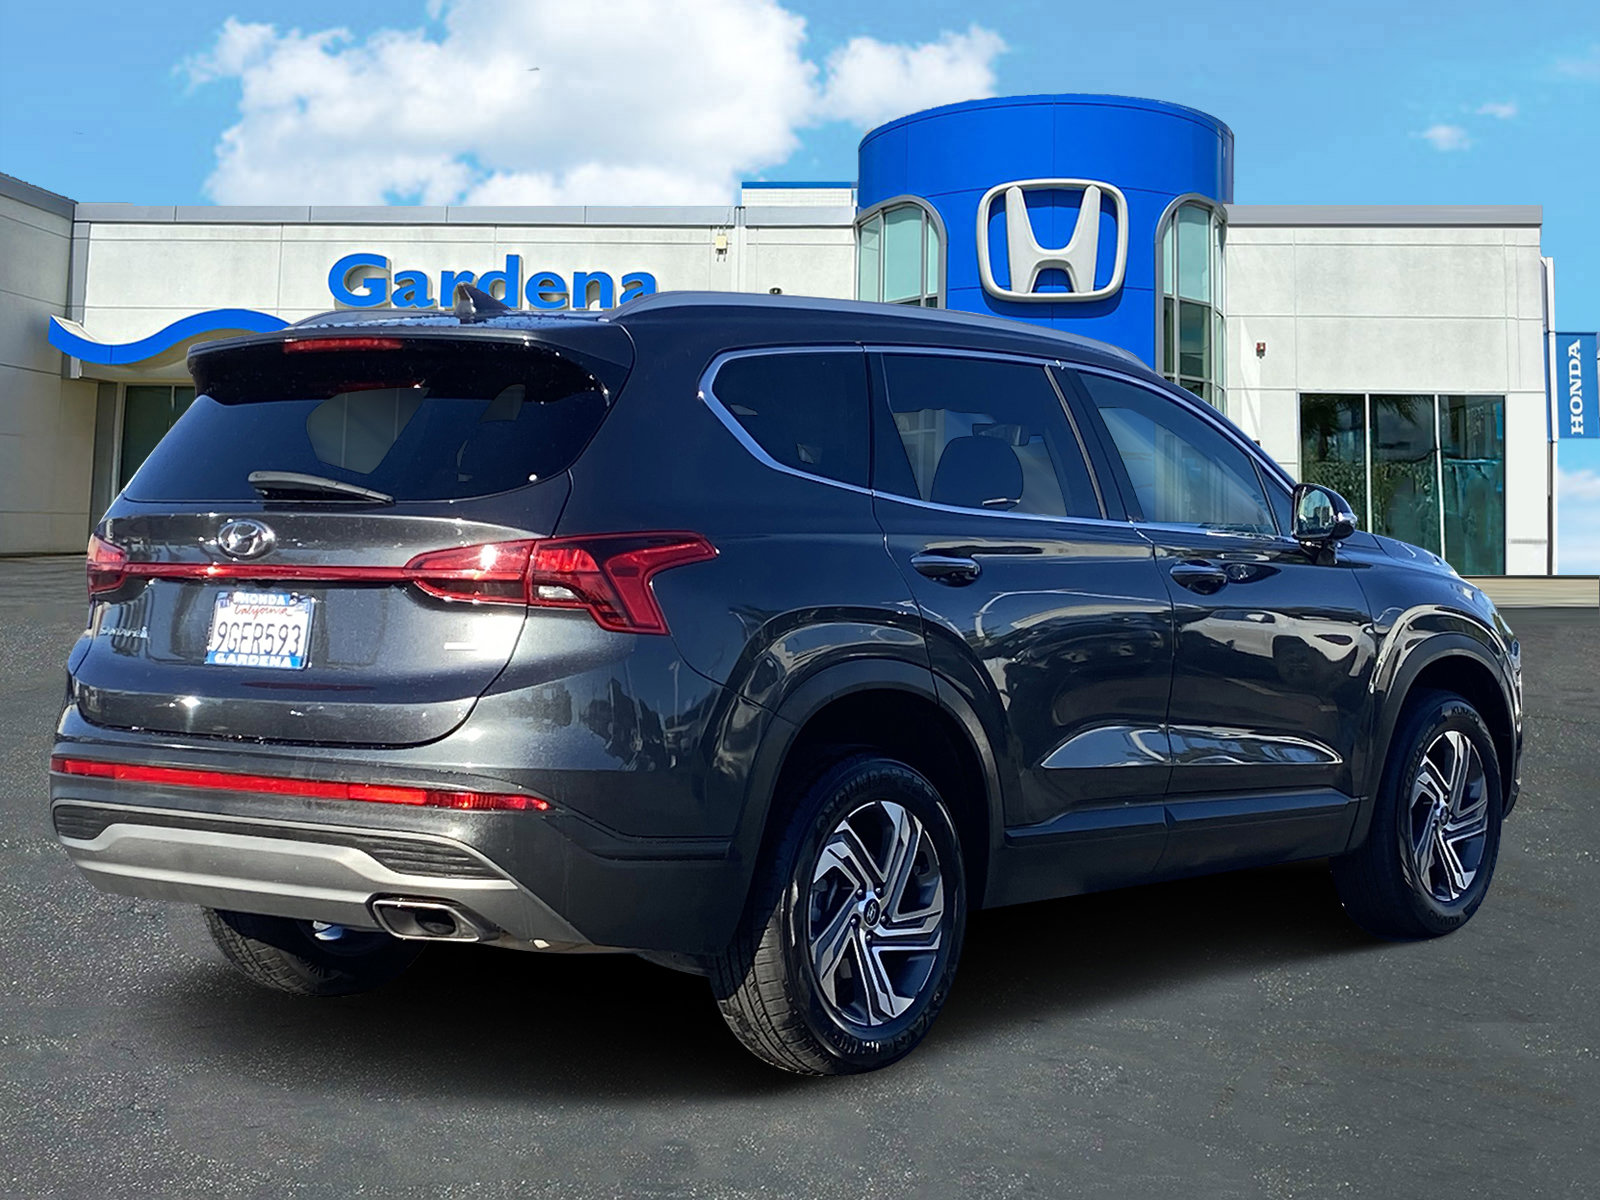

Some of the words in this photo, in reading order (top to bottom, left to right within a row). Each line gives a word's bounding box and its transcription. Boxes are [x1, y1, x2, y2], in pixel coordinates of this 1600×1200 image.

[328, 252, 657, 309] Gardena
[1568, 339, 1584, 435] HONDA
[237, 592, 287, 606] HONDA
[234, 602, 292, 620] California
[214, 652, 293, 668] GARDENA
